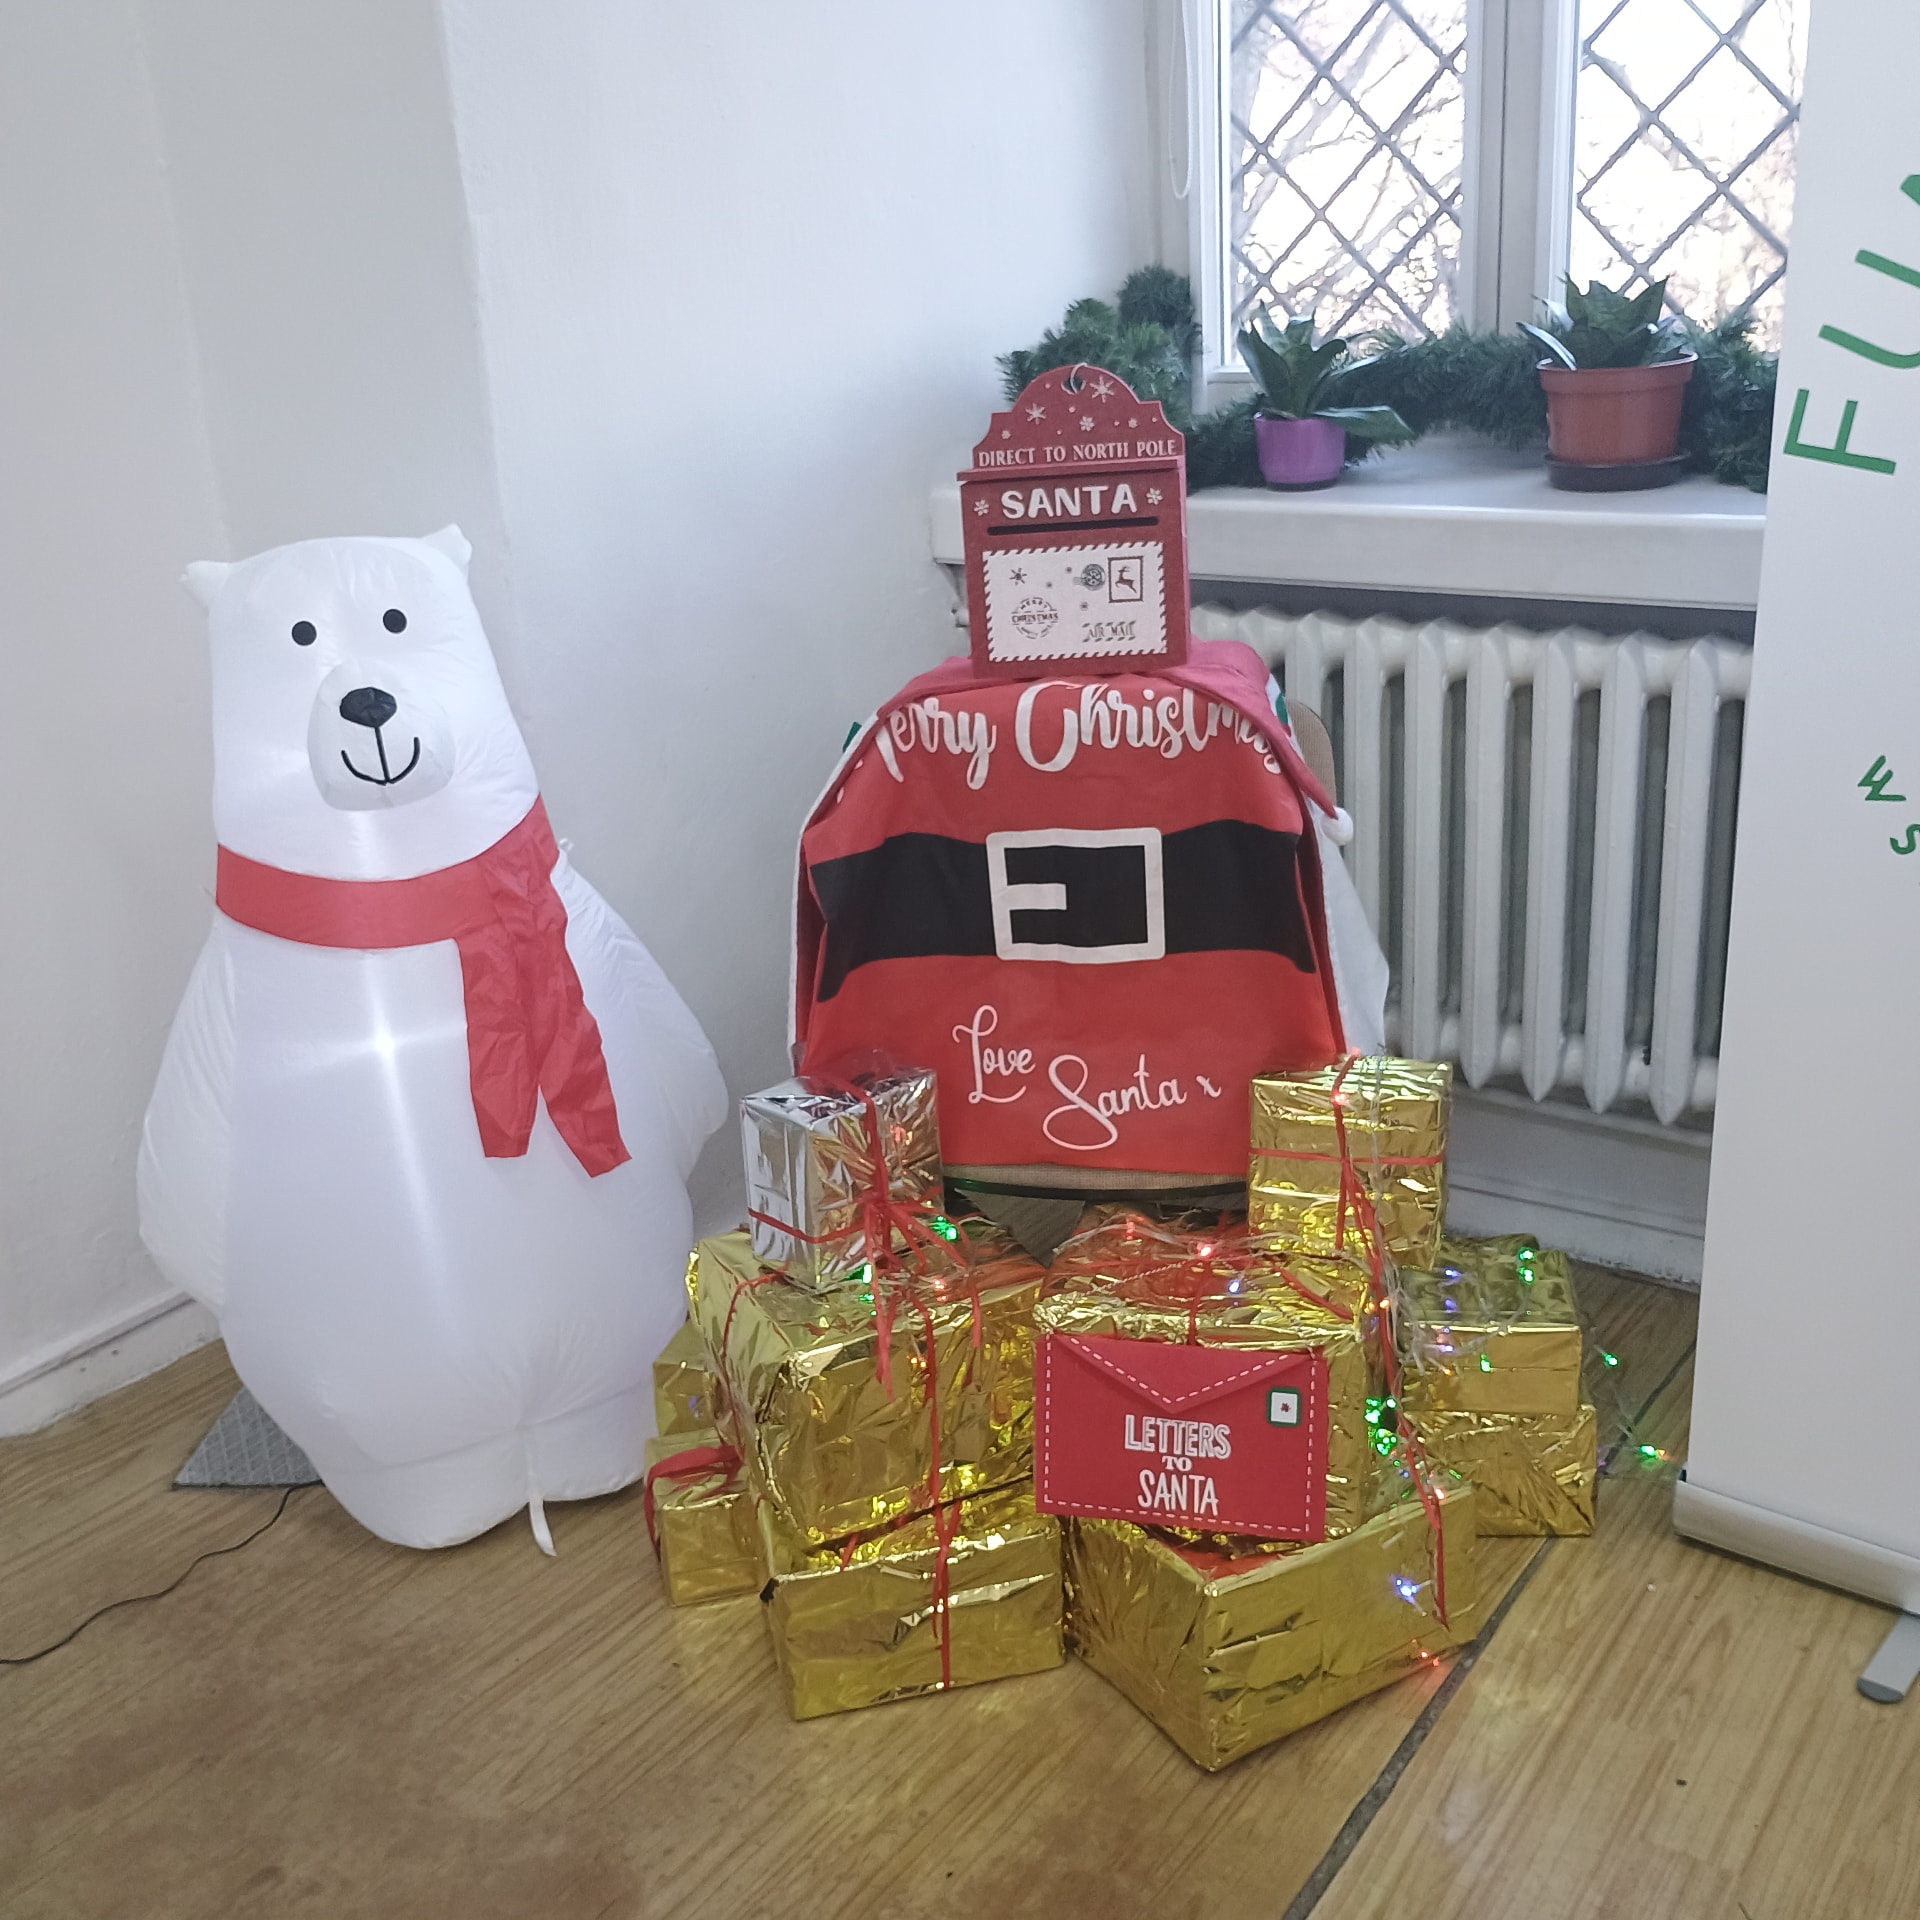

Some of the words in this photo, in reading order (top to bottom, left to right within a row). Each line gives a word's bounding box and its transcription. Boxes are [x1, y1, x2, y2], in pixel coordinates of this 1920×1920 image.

[1783, 174, 1920, 476] FU
[978, 447, 1036, 467] DIRECT
[1043, 446, 1067, 464] TO
[1073, 442, 1129, 462] NORTH
[1136, 439, 1177, 457] POLE
[1001, 483, 1138, 519] SANTA
[952, 1004, 1036, 1104] Love
[1042, 1054, 1188, 1151] Santa
[1124, 1414, 1232, 1460] LETTERS
[1161, 1455, 1193, 1472] TO
[1137, 1469, 1219, 1517] SANTA
